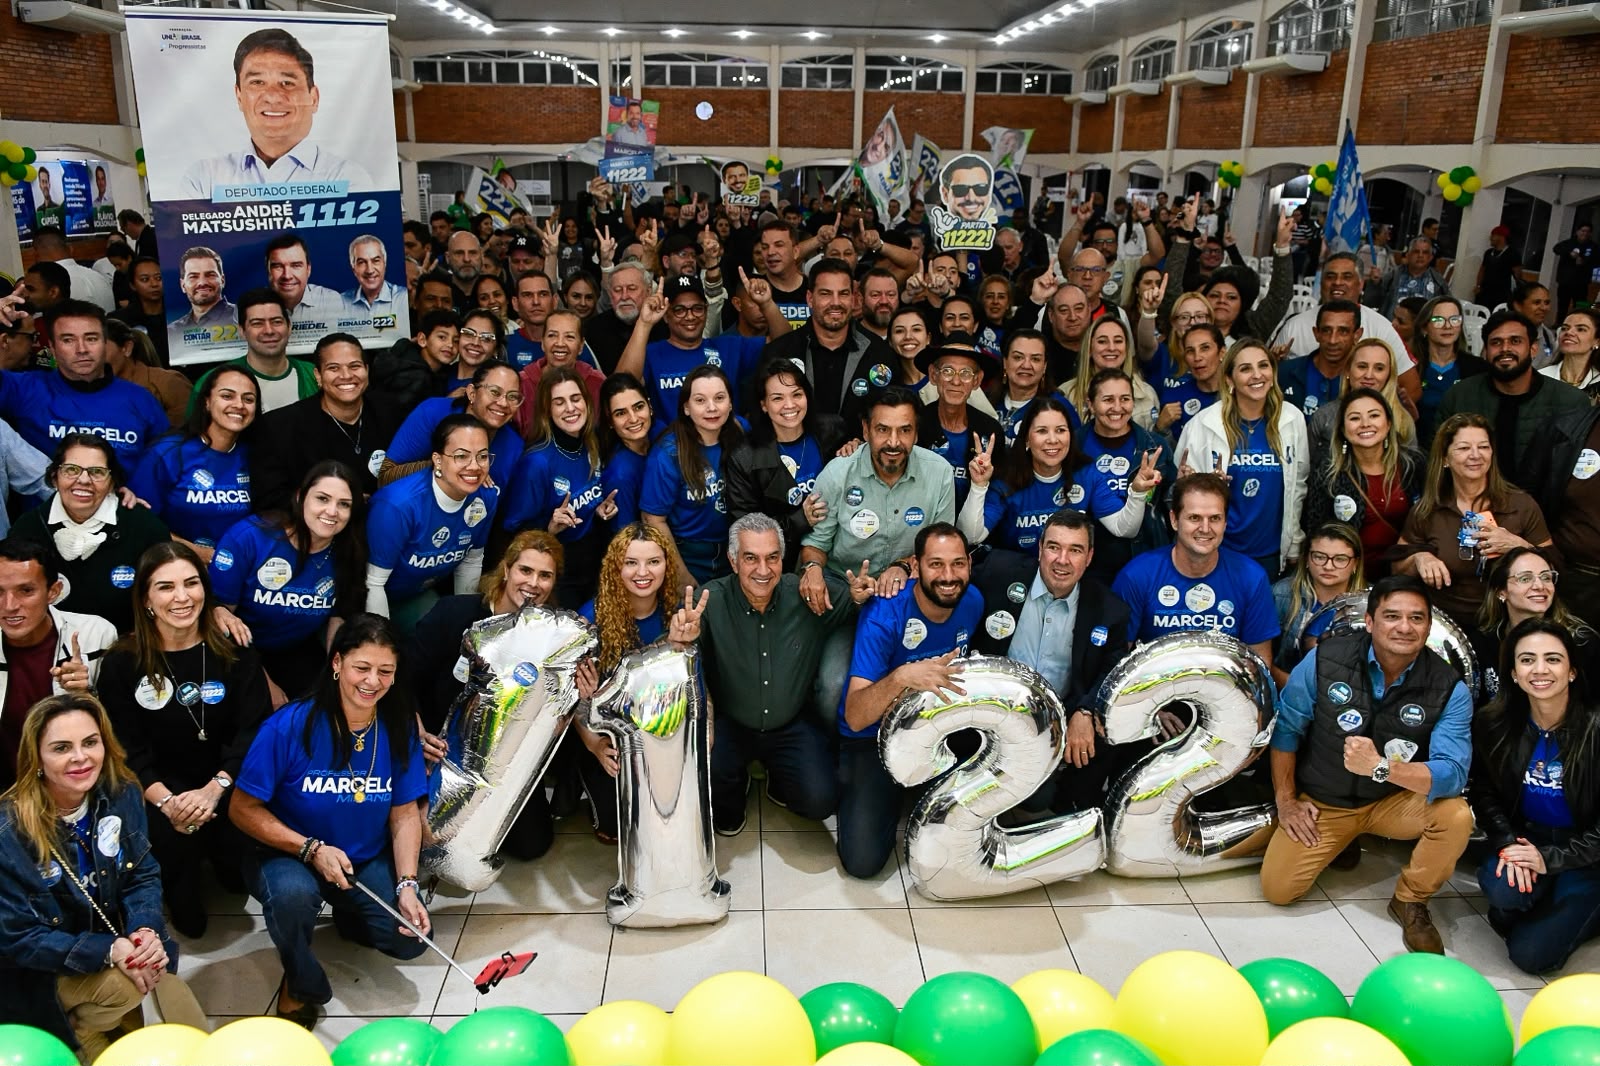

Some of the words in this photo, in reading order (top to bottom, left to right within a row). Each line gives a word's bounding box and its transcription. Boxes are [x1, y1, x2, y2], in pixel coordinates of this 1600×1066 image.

[607, 166, 647, 182] 11222
[225, 186, 287, 198] DEPUTADO
[290, 184, 339, 195] FEDERAL
[728, 194, 758, 204] 1222
[182, 211, 231, 221] DELEGADO
[233, 200, 293, 218] ANDRÉ
[296, 199, 379, 228] 1112
[183, 216, 295, 234] MATSUSHITA
[960, 221, 988, 231] PARTIU
[944, 230, 990, 247] 11222!
[291, 322, 328, 331] RIEDEL
[374, 317, 394, 327] 222
[1229, 454, 1280, 466] ARCEL
[568, 484, 602, 512] MARC
[1153, 614, 1236, 628] MARCELO
